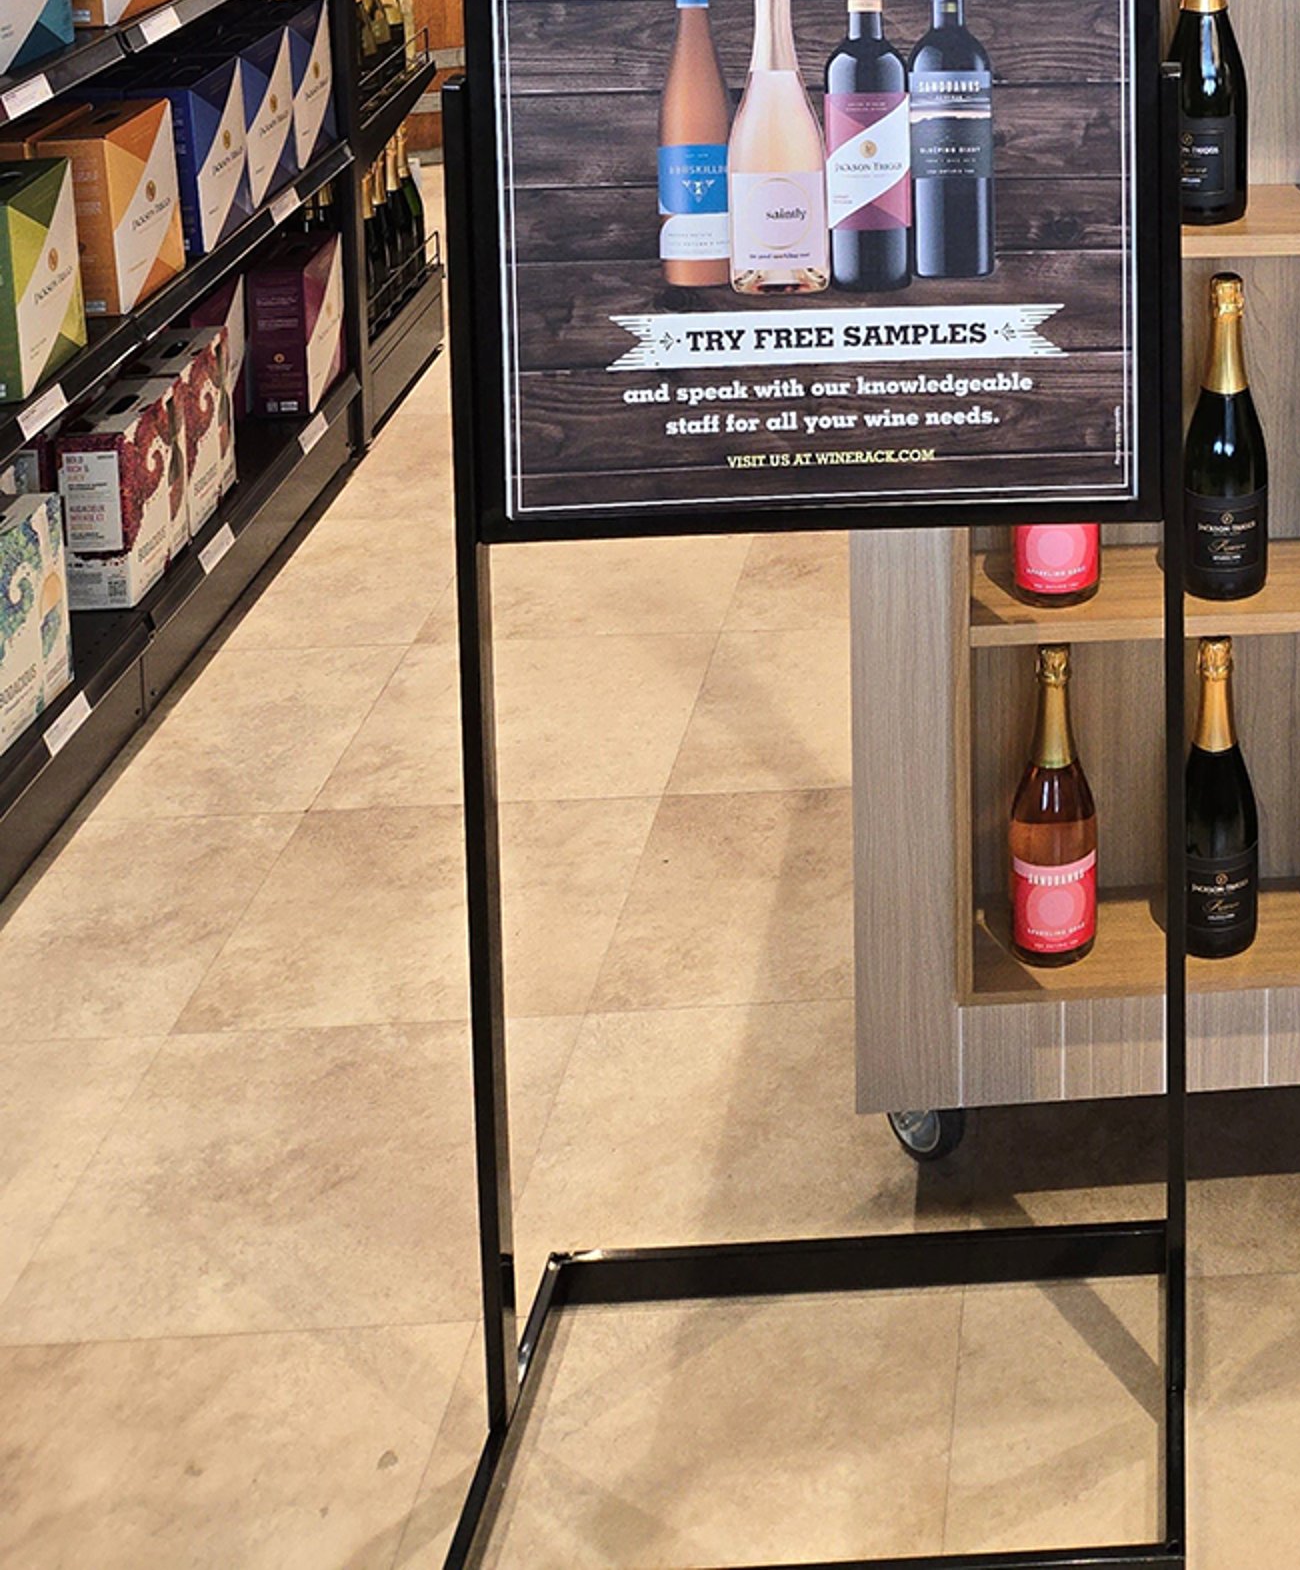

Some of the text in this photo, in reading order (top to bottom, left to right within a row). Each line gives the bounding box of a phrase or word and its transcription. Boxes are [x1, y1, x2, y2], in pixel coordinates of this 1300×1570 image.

[765, 207, 807, 221] saintly
[685, 323, 988, 353] TRY FREE SAMPLES
[623, 371, 1034, 408] and speak with our knowledgeable
[665, 405, 1001, 437] staff for all your wine needs.
[726, 448, 936, 470] VISIT US AT WINERACK.COM
